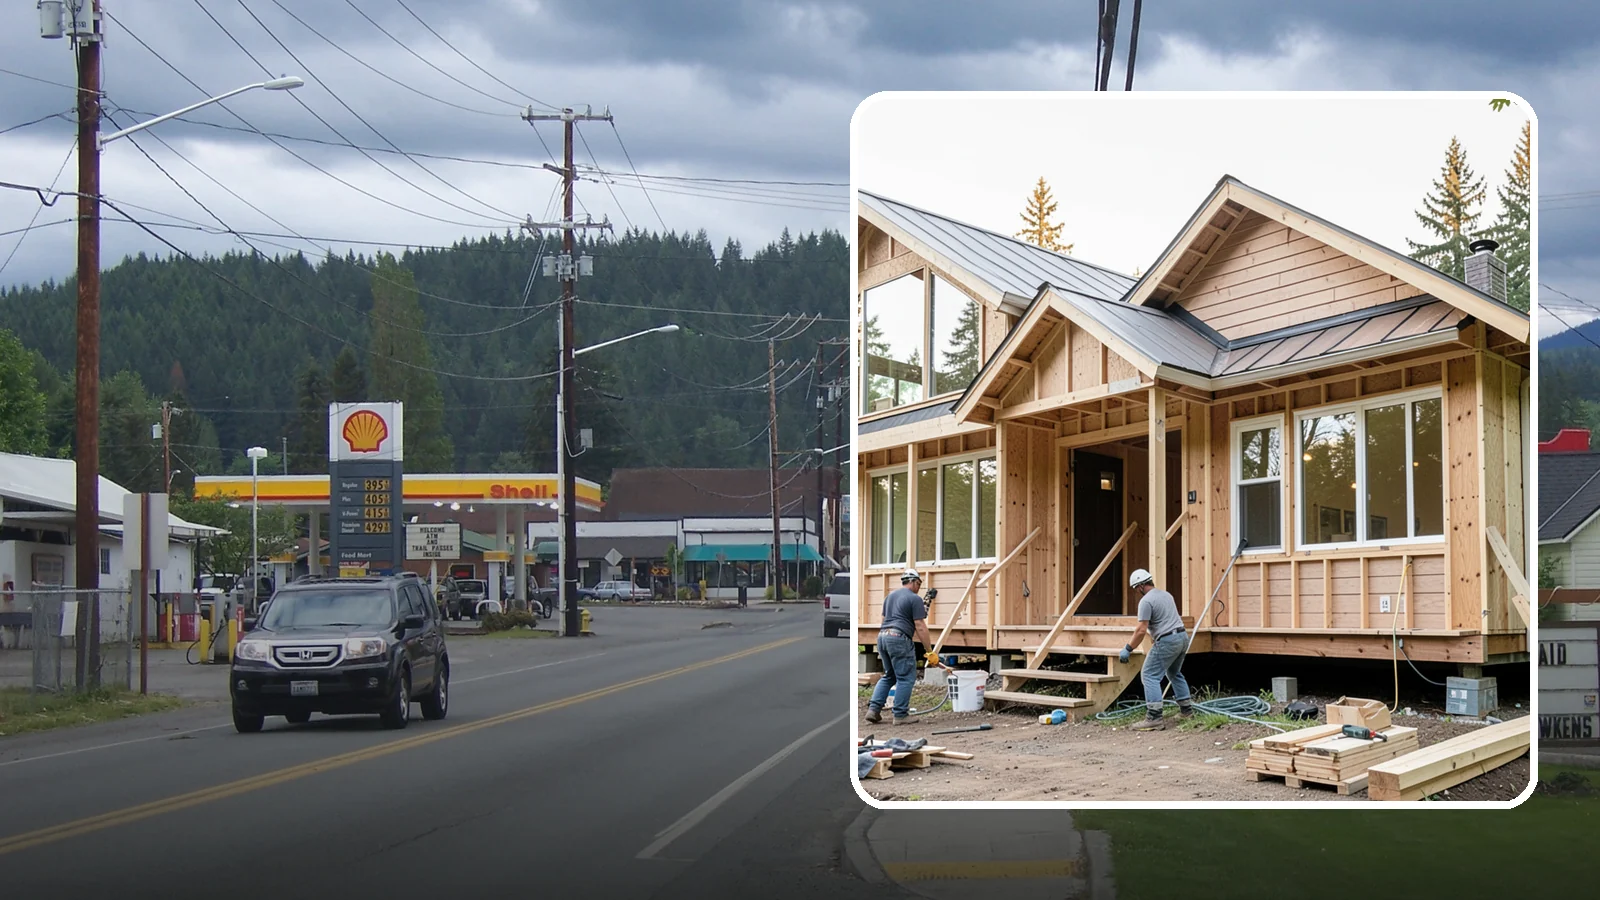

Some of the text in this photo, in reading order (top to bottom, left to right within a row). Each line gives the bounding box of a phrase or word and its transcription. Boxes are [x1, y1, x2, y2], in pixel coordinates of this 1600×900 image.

[365, 480, 383, 490] 395
[490, 484, 547, 499] Shell
[365, 494, 383, 504] 405
[365, 508, 383, 518] 415
[365, 522, 383, 532] 429
